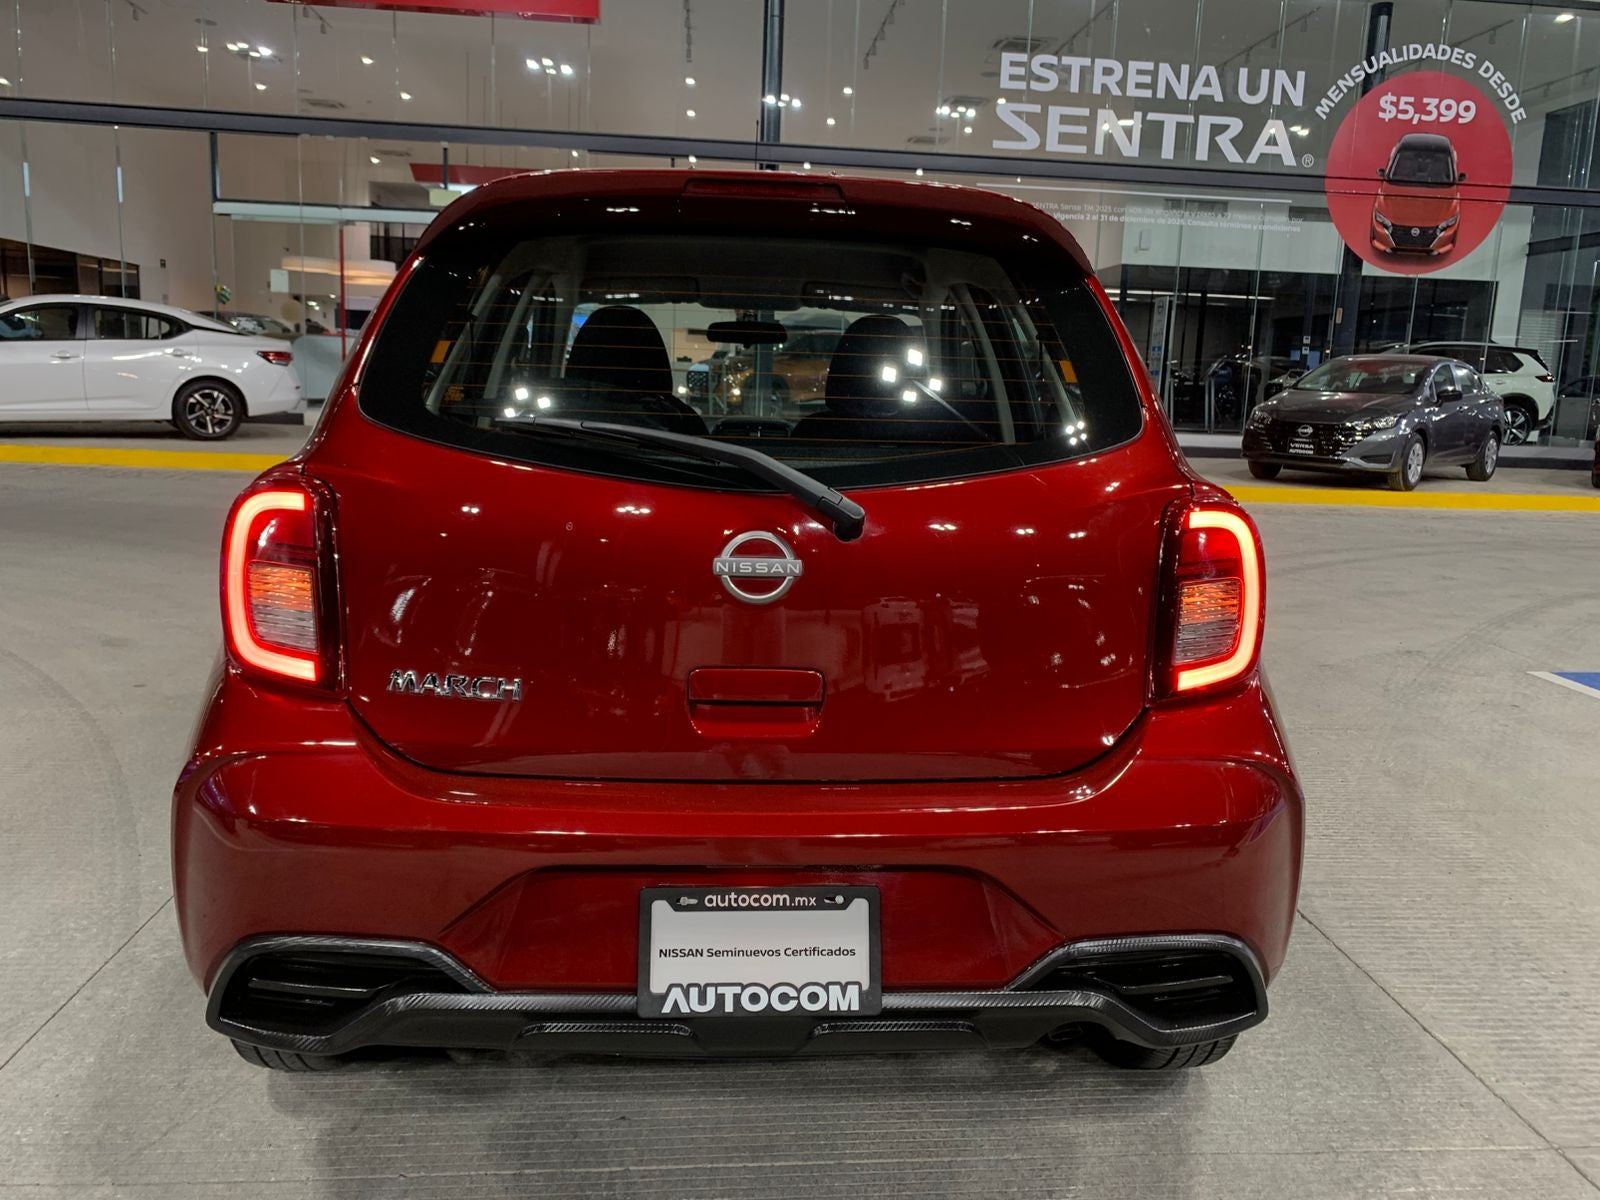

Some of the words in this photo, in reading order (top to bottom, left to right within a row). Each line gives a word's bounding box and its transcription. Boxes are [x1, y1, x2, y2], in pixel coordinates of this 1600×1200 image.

[1000, 52, 1224, 103] ESTRENA
[1238, 67, 1305, 107] UN
[1314, 43, 1478, 121] MENSUALIDADES
[1478, 60, 1527, 124] DESDE
[1378, 92, 1476, 125] $5,399
[992, 103, 1297, 167] SENTRA
[716, 562, 800, 574] NISSAN
[387, 669, 522, 701] MARCH
[704, 891, 817, 908] autocom.mx
[658, 947, 704, 959] NISSAN
[706, 946, 782, 959] Seminuevos
[783, 945, 857, 959] Certificados
[660, 984, 861, 1014] AUTOCOM
